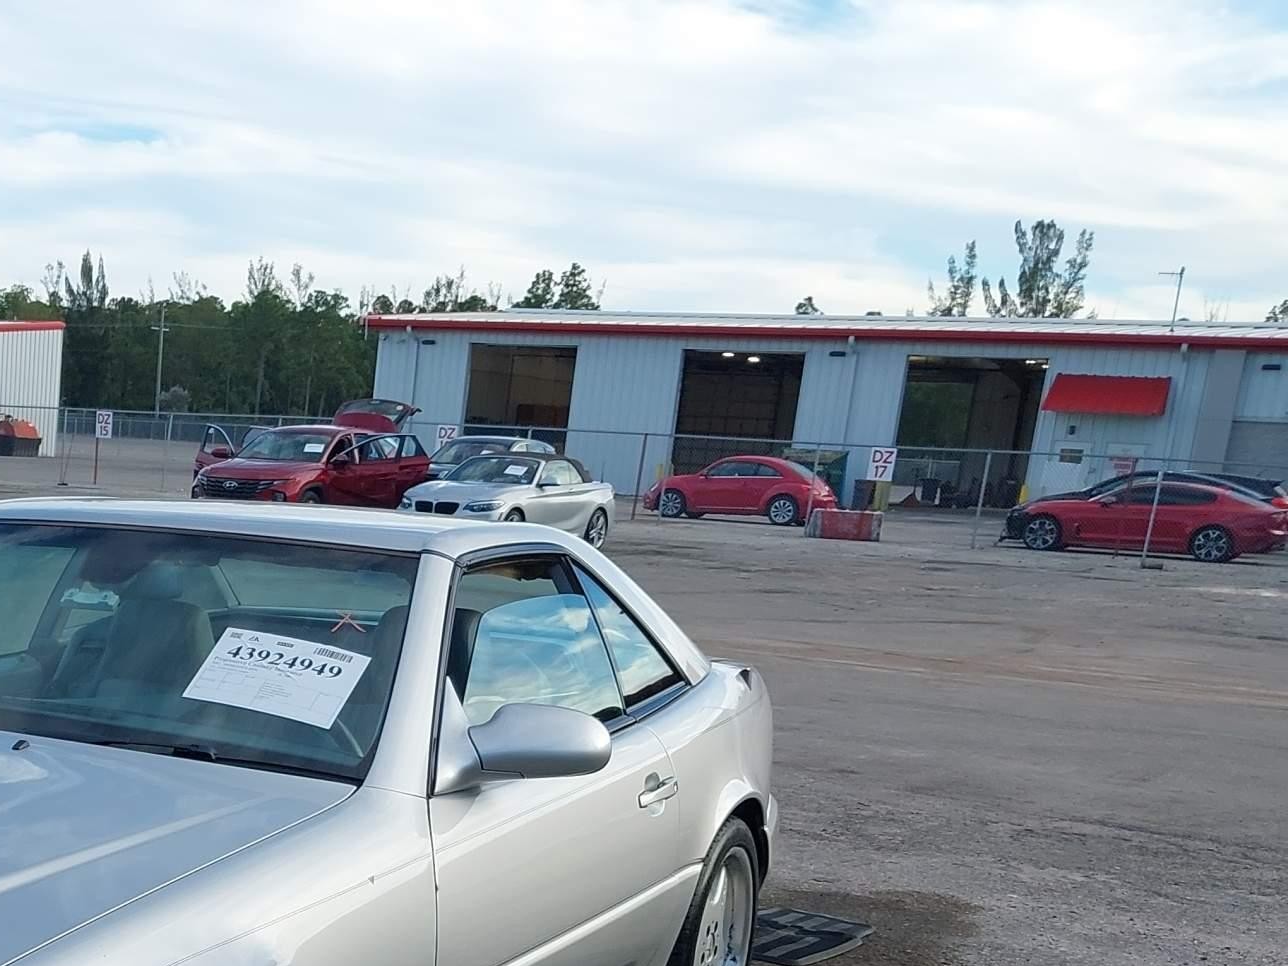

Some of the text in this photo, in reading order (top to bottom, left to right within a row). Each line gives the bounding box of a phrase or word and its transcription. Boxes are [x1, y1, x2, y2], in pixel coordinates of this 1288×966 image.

[98, 413, 111, 424] DZ
[99, 425, 109, 436] 15
[438, 427, 456, 439] DZ
[872, 450, 895, 464] DZ
[874, 465, 888, 478] 17
[227, 645, 343, 679] 43924949
